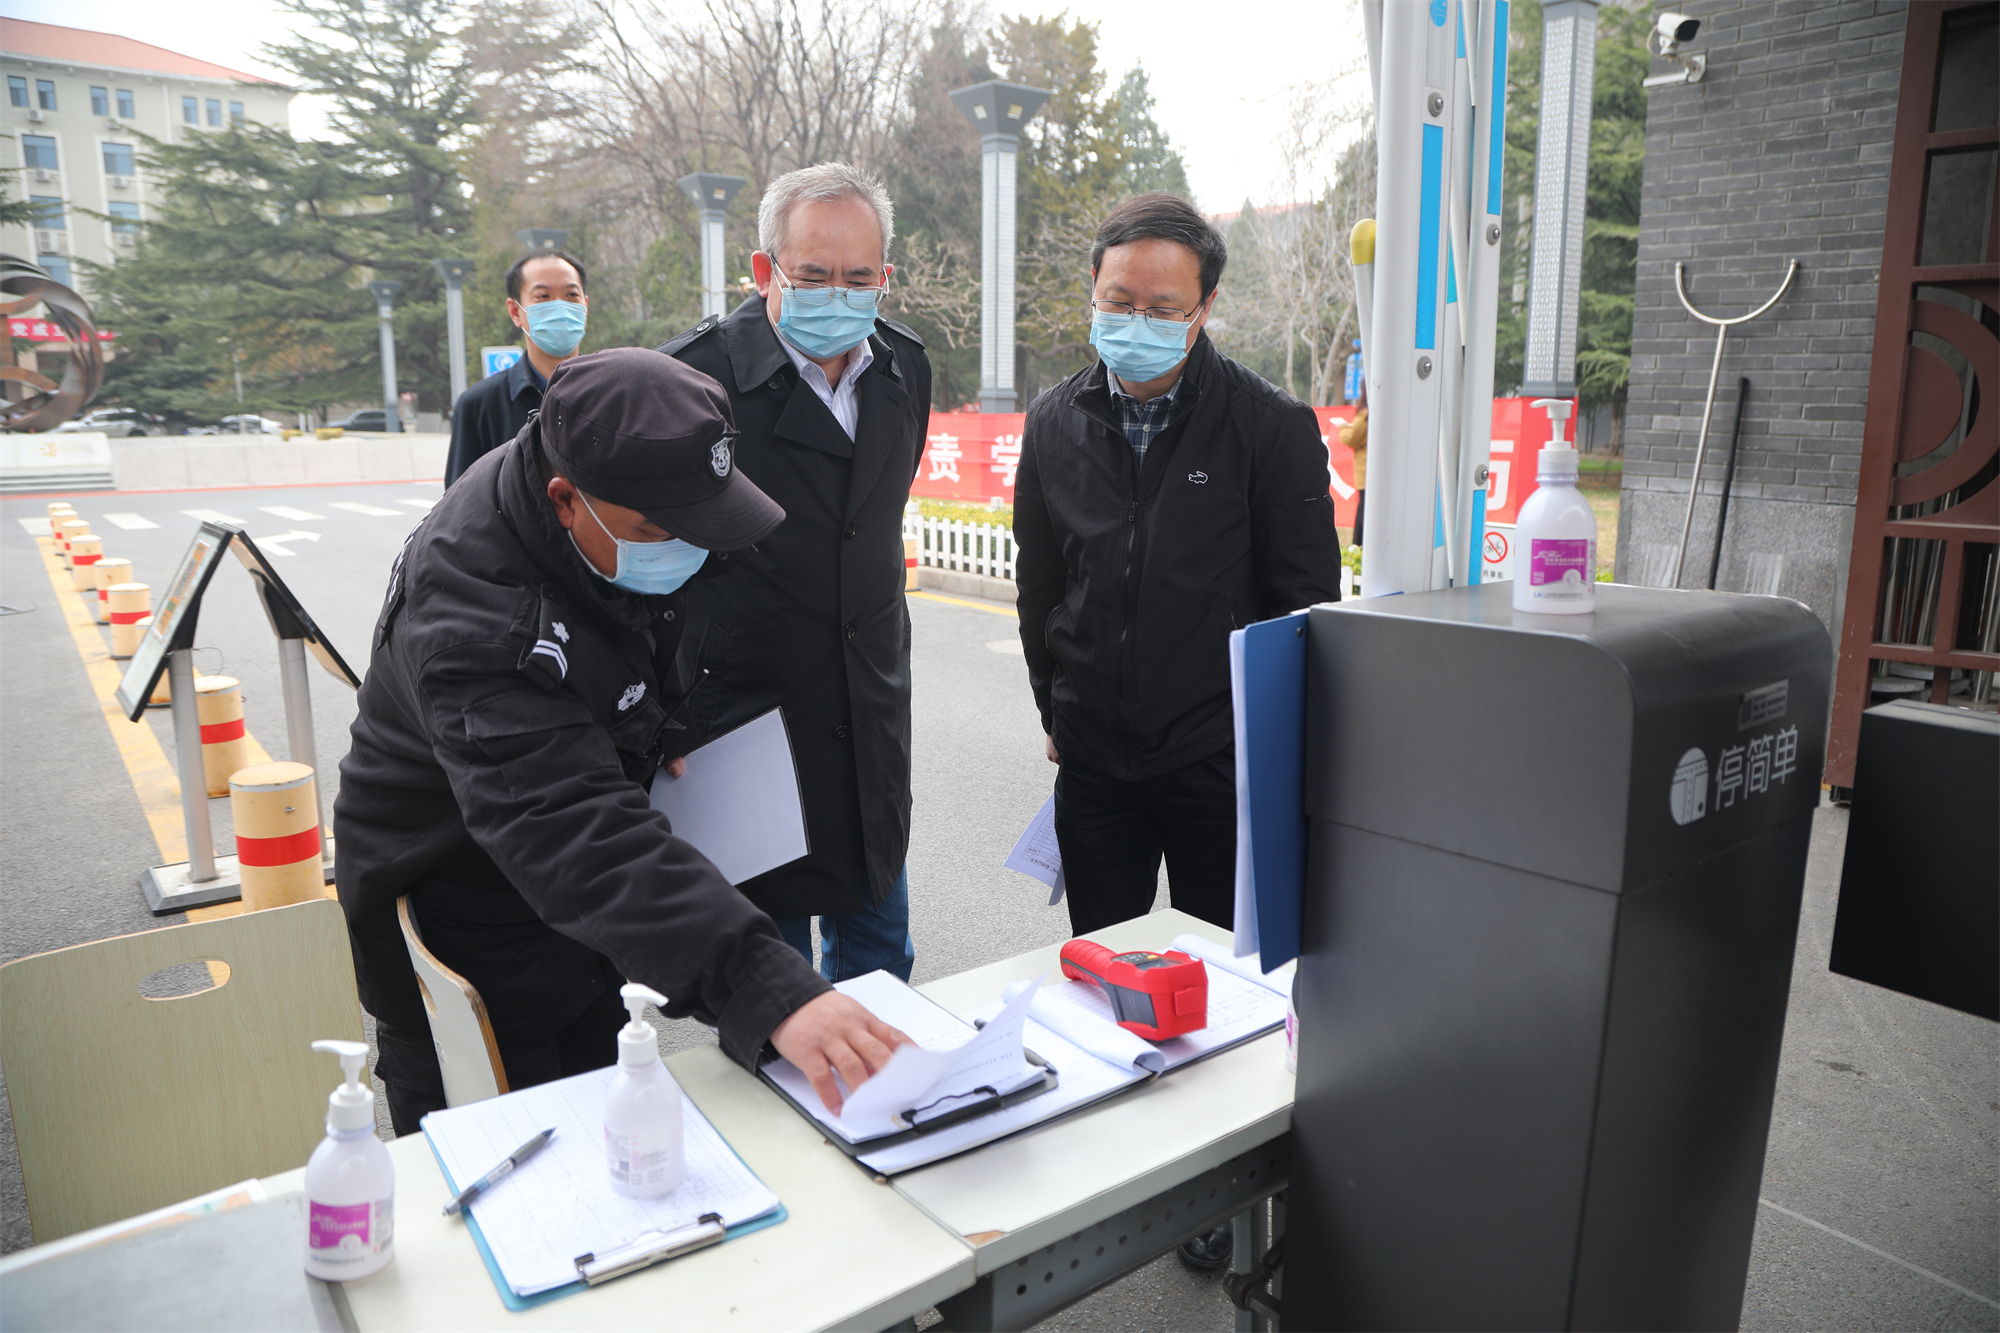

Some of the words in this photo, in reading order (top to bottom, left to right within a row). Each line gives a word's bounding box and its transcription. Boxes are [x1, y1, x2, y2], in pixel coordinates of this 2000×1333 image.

[914, 432, 962, 483] 责
[990, 434, 1023, 487] 学
[1715, 724, 1798, 812] 停简单
